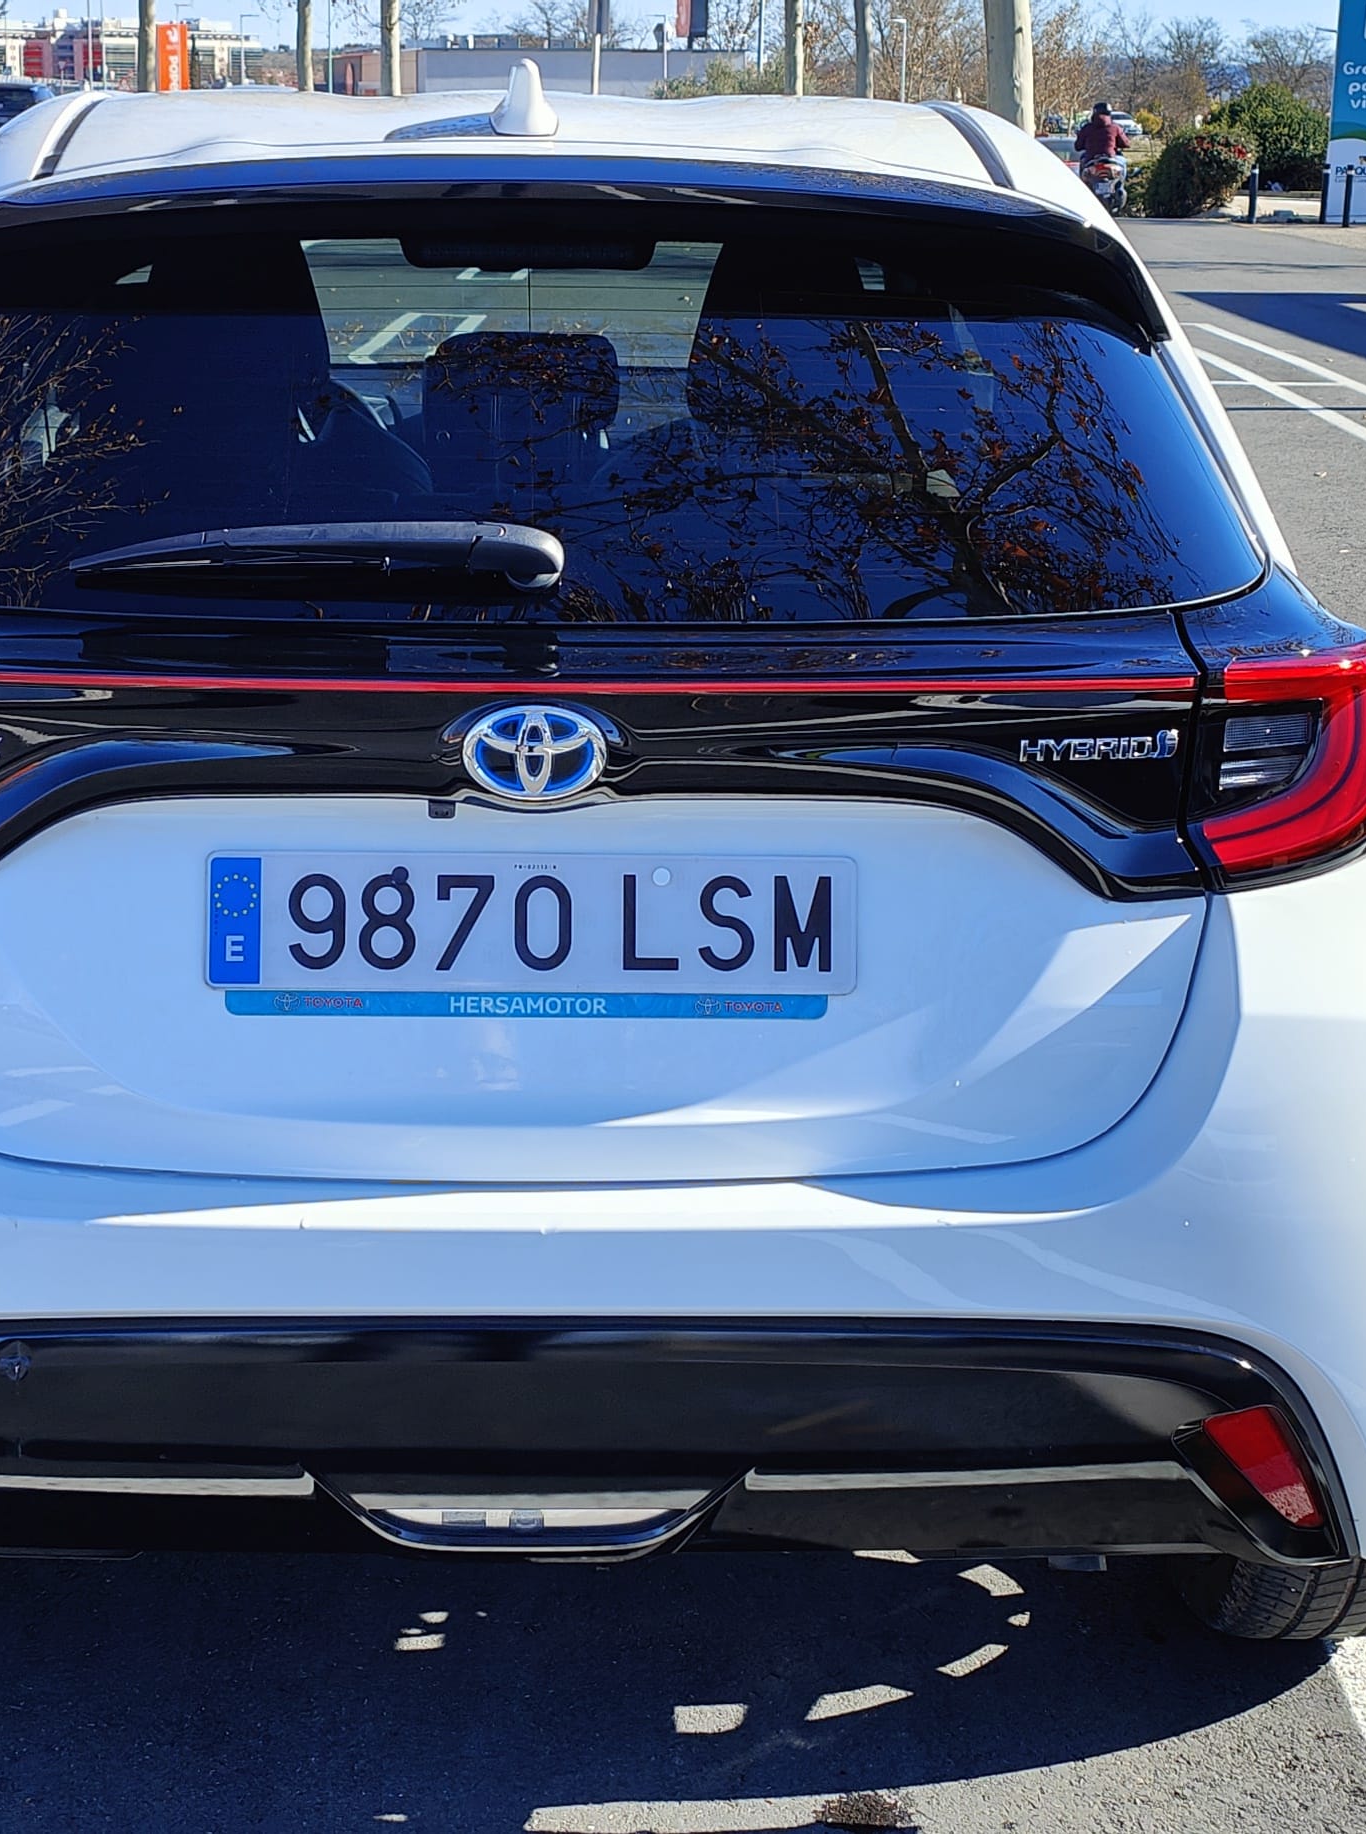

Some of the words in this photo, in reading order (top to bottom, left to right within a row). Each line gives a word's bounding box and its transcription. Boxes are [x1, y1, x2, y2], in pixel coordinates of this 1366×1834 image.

[1019, 736, 1153, 763] HYBRID
[288, 873, 573, 971] 9870
[622, 874, 832, 972] LSM
[225, 935, 245, 962] E
[303, 996, 364, 1009] TOYOTA
[449, 996, 607, 1014] HERSAMOTOR
[723, 1000, 783, 1013] TOYOTA
